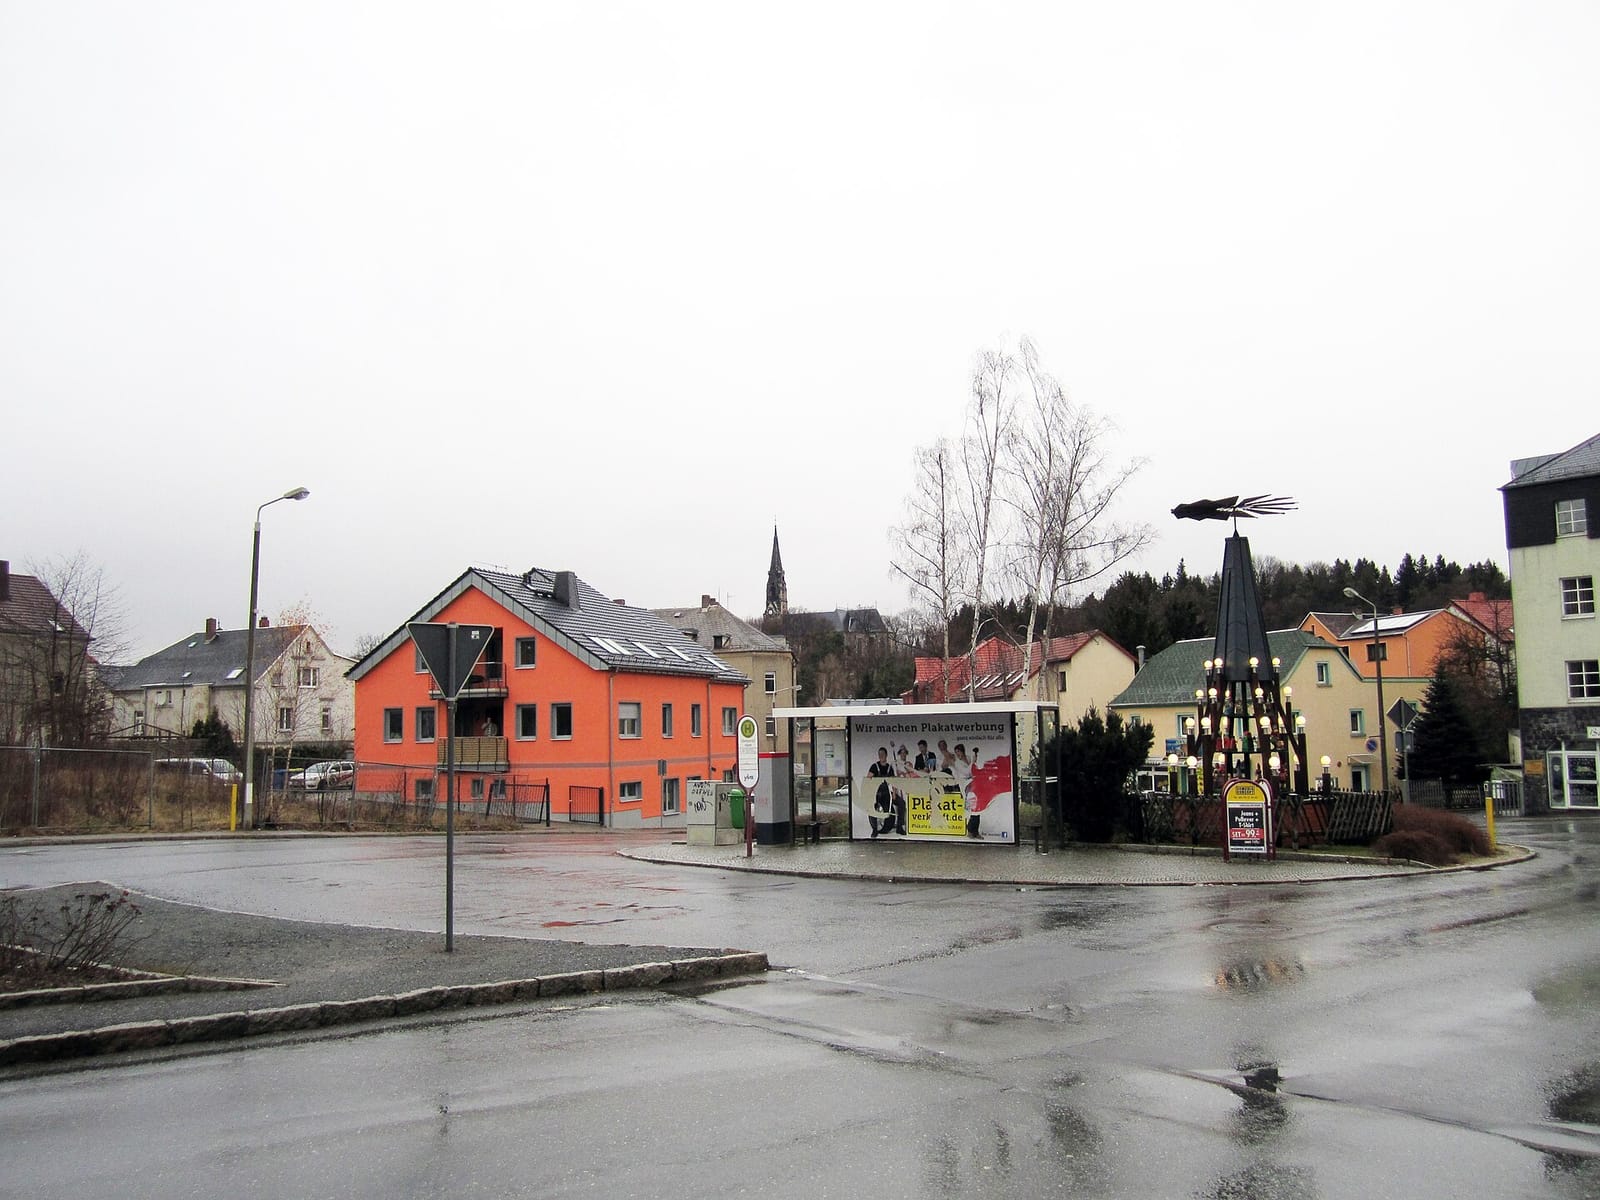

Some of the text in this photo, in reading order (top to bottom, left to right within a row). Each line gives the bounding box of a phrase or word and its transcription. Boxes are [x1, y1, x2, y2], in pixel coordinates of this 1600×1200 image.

[855, 722, 1005, 734] Wir machen Plakatwerbung
